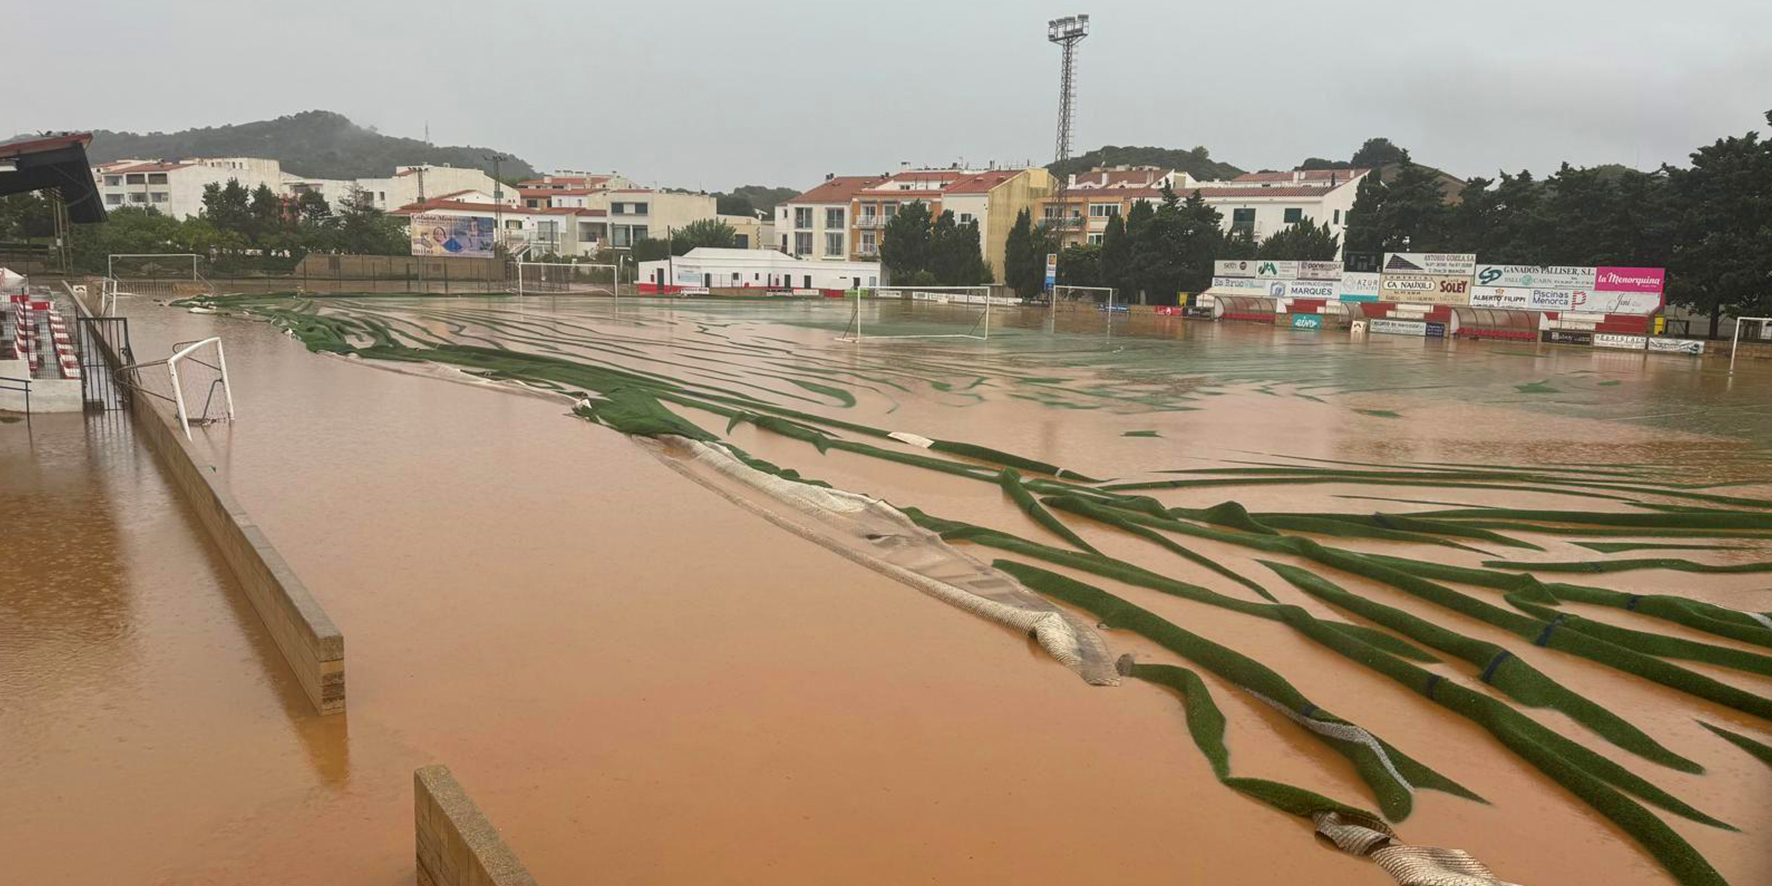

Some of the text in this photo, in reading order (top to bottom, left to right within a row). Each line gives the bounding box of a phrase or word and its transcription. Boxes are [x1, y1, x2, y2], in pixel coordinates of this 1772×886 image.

[1503, 266, 1539, 274] GANADOS
[1225, 279, 1244, 287] Bruc
[1607, 272, 1661, 286] Menorquina
[1440, 280, 1468, 293] SOLEY
[1533, 289, 1569, 298] Piscinas
[1532, 297, 1569, 305] Menorca
